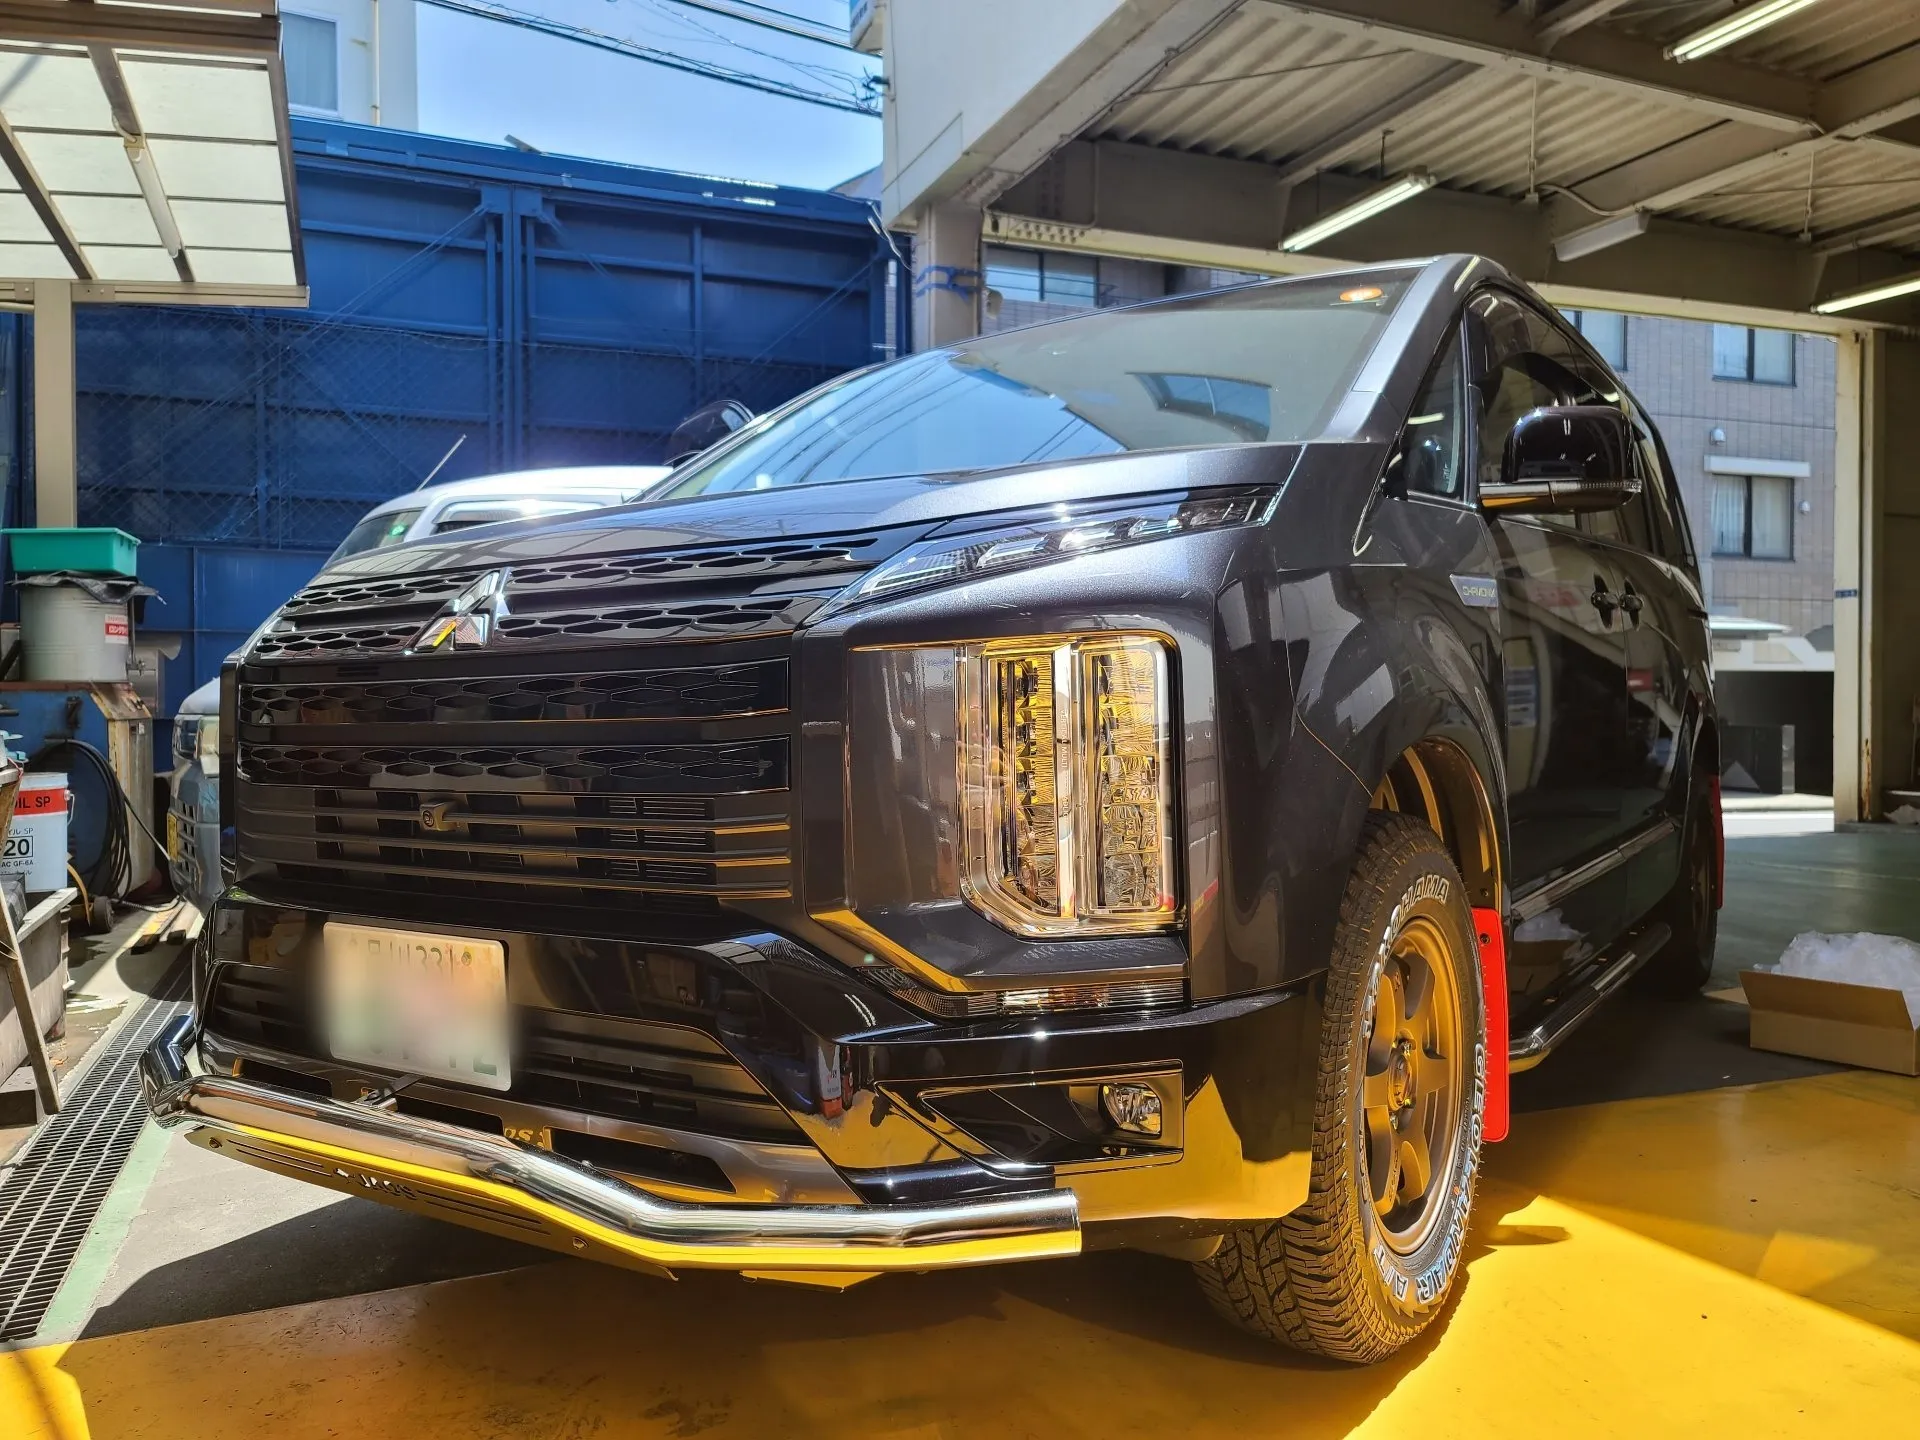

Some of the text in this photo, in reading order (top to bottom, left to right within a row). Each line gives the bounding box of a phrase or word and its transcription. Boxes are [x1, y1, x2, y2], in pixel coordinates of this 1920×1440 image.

[35, 796, 51, 808] SP
[24, 827, 34, 835] SP
[3, 838, 30, 857] 20
[1416, 1043, 1486, 1304] GEOLANDAR
[1373, 1244, 1409, 1301] A/T
